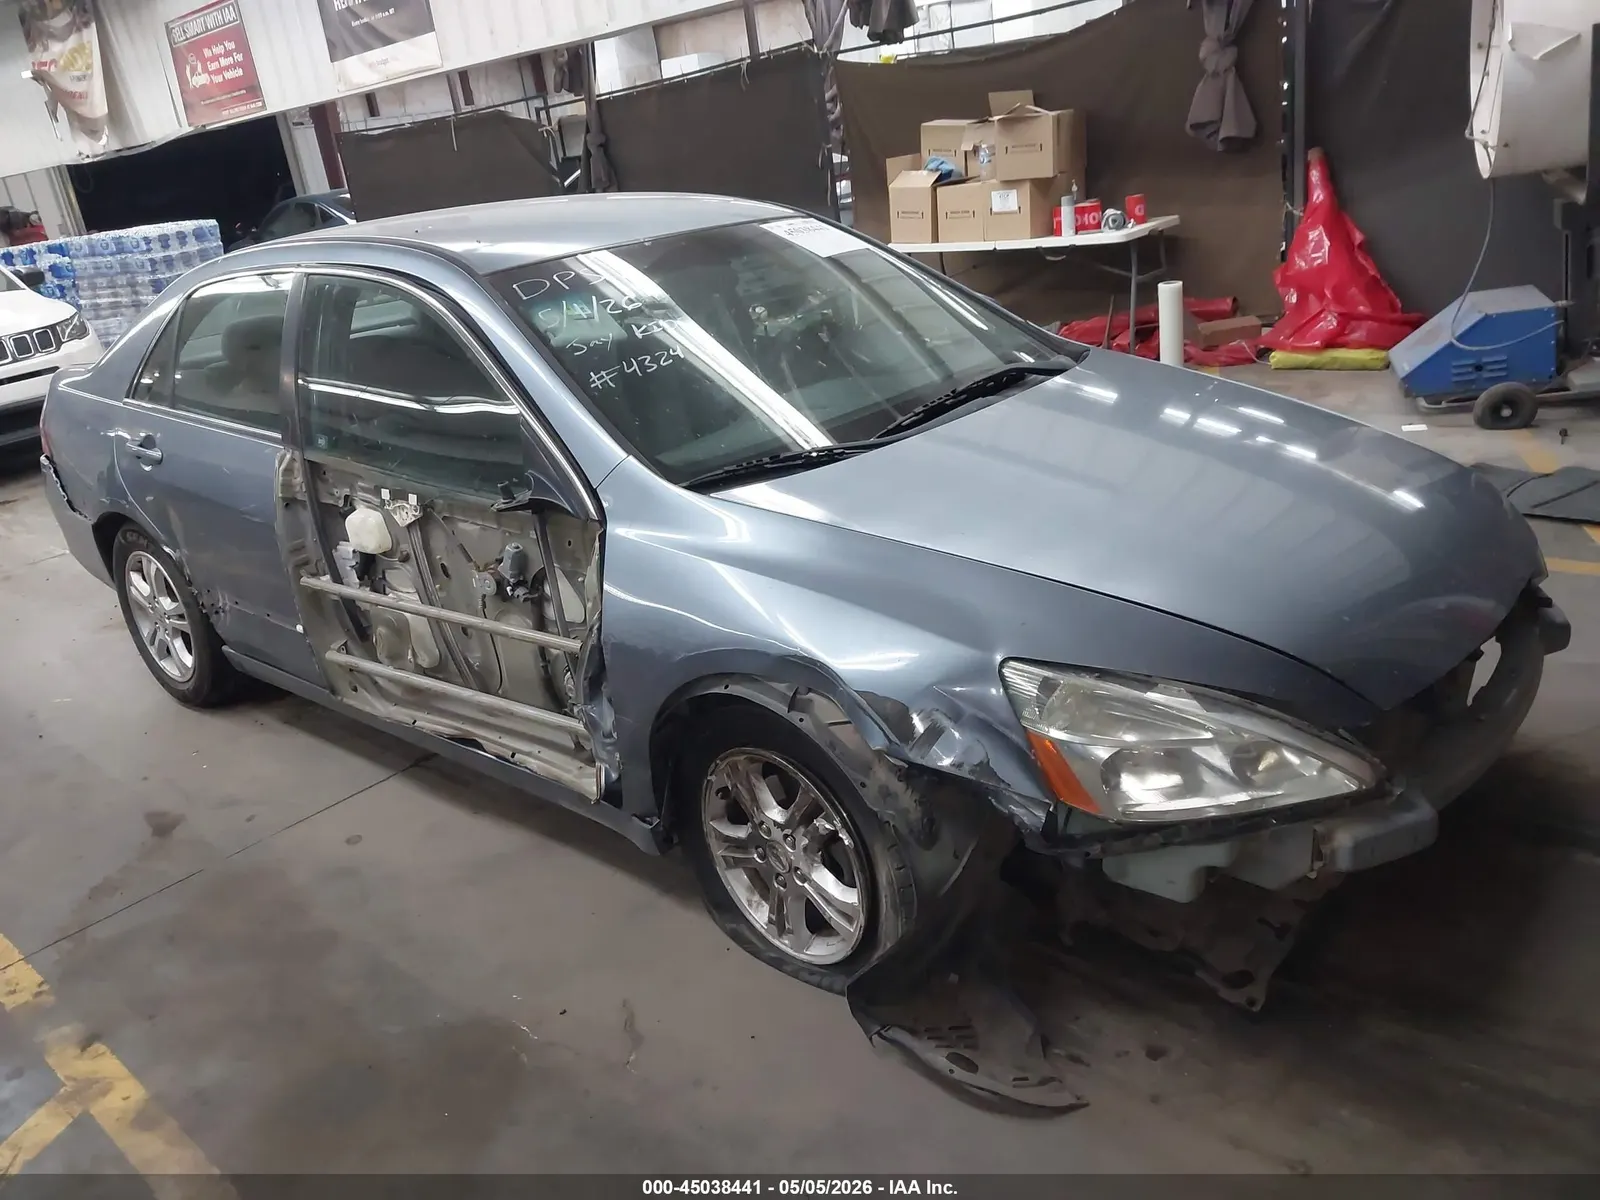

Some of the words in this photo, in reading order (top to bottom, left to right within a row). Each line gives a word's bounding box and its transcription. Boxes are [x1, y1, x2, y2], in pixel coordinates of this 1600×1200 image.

[184, 16, 206, 39] SMART
[205, 10, 224, 30] WITH
[222, 4, 237, 23] IAA
[202, 47, 212, 59] We
[211, 43, 225, 55] Help
[223, 40, 236, 51] You
[206, 60, 220, 72] Earn
[219, 56, 234, 67] More
[232, 52, 243, 63] For
[210, 73, 223, 84] Your
[222, 66, 244, 80] Vehicle
[512, 268, 607, 300] DPS
[589, 345, 685, 390] #4324
